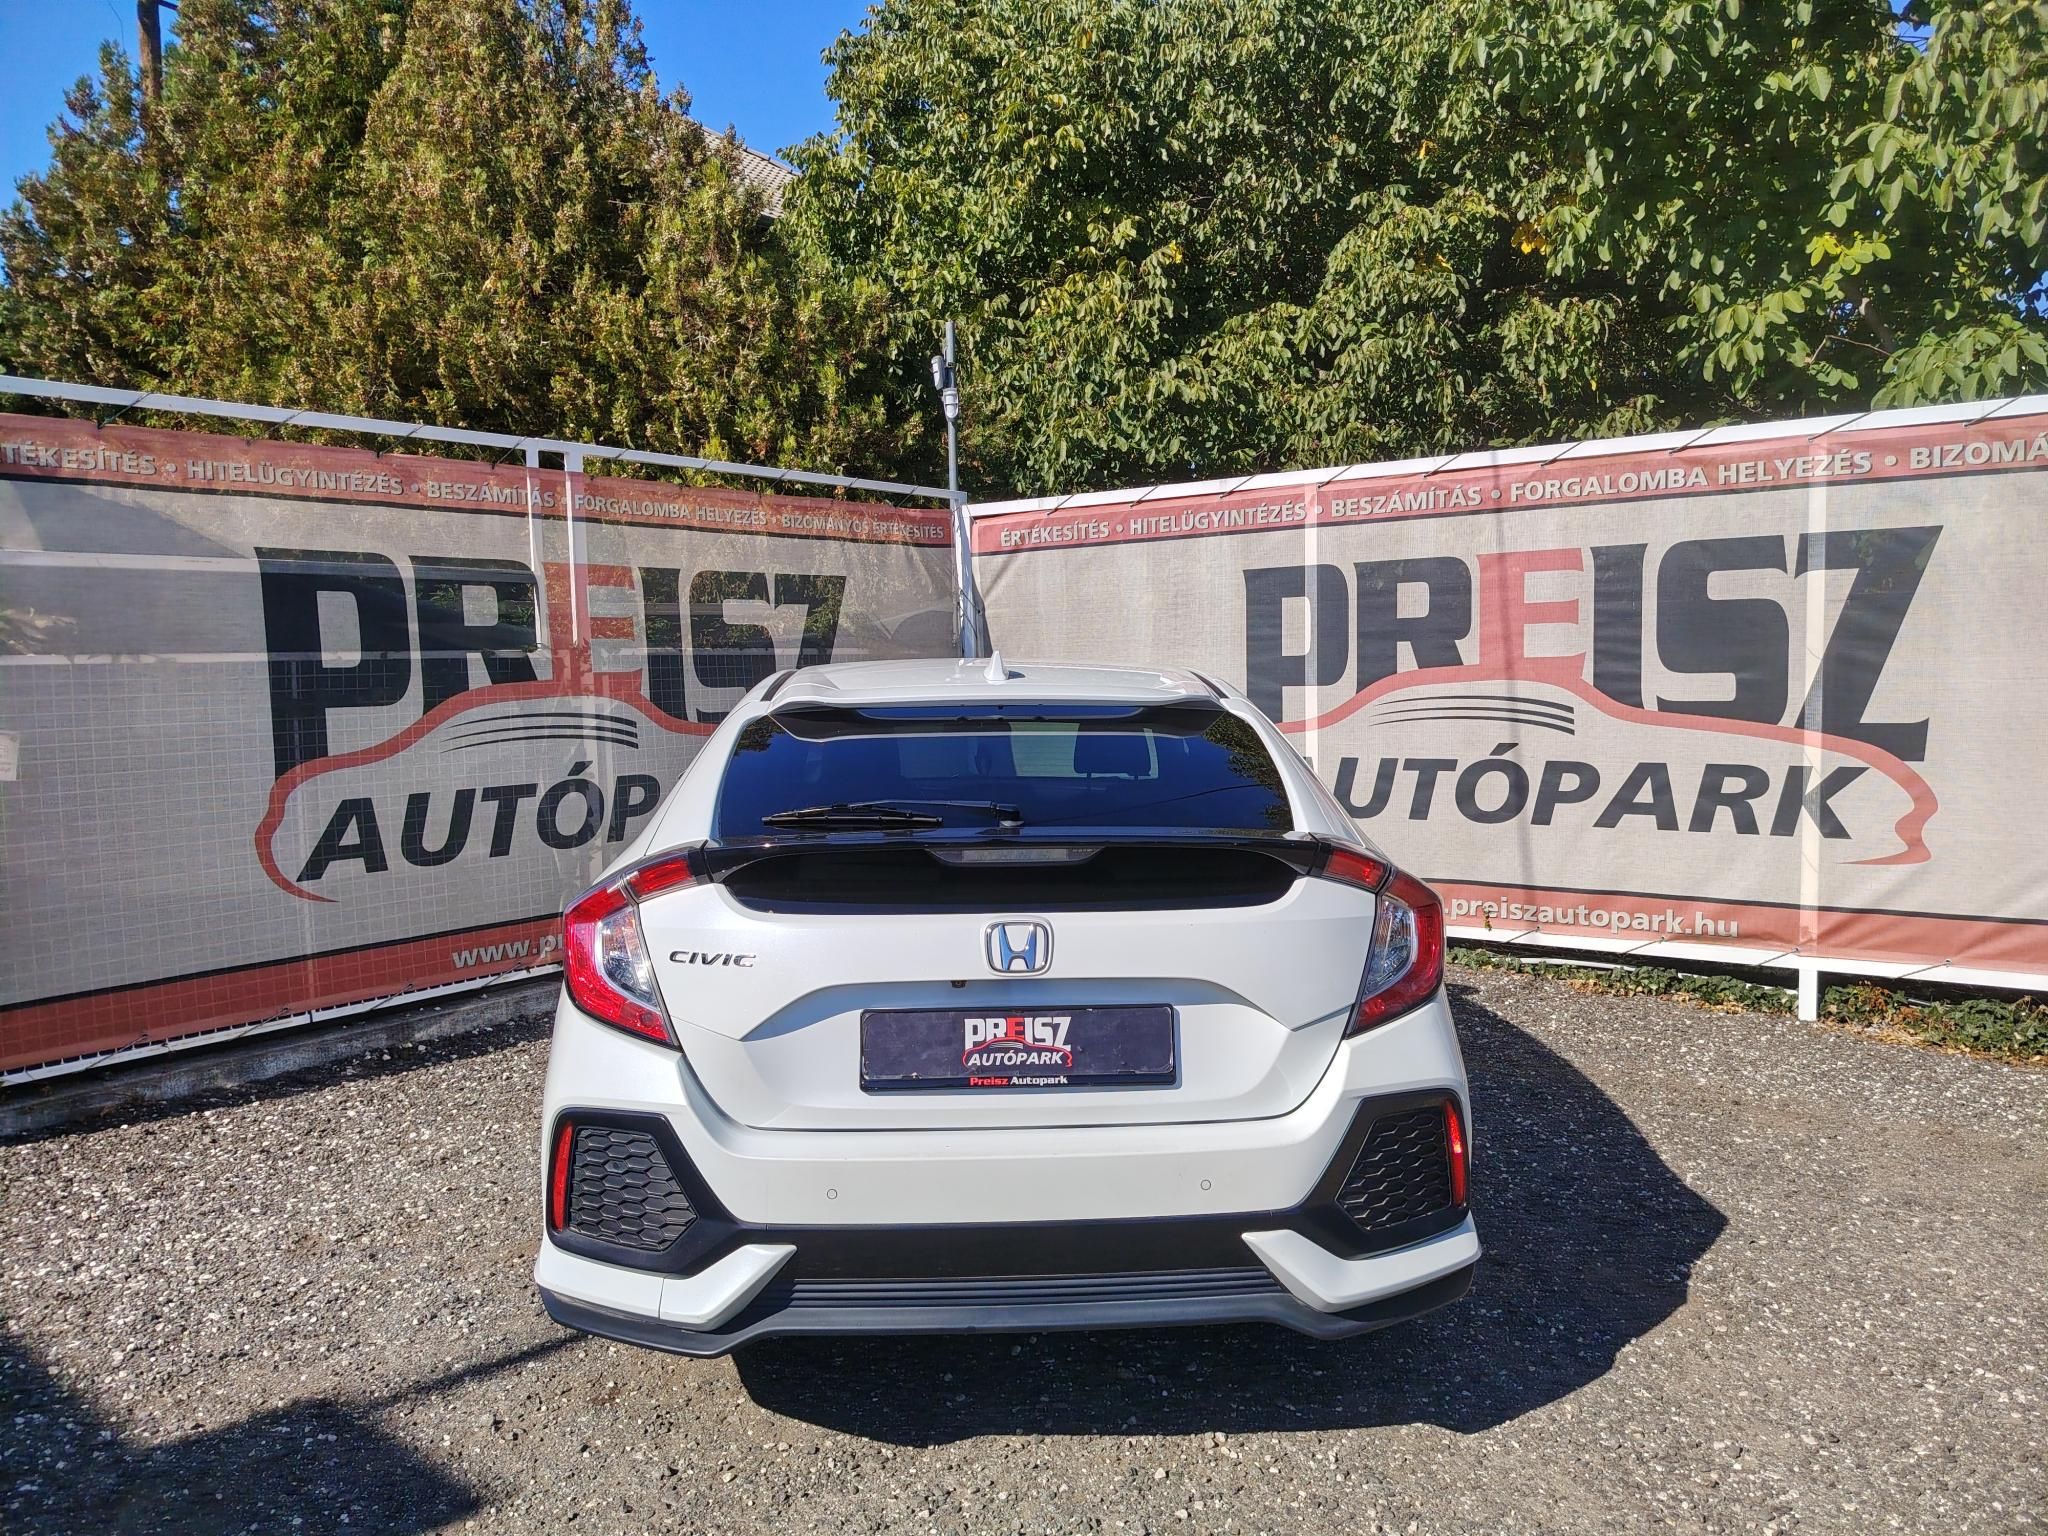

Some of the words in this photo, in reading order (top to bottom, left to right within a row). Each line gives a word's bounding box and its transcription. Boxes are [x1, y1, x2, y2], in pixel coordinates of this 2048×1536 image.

[0, 441, 157, 475] TÉKESÍTÉS
[186, 460, 405, 495] HITELÜGYINTÉZÉS
[427, 481, 556, 508] BESZÁMÍTÁS
[575, 494, 692, 519] FORGALOMBA
[695, 506, 767, 526] HELYEZÉS
[1000, 518, 1110, 547] ÉRTÉKESÍTÉS
[1129, 500, 1307, 535] HITELÜGYINTÉZÉS
[1331, 485, 1483, 518] BESZÁMÍTÁS
[1510, 466, 1710, 502] FORGALOMBA
[1717, 448, 1873, 486] HELYEZÉS
[1910, 431, 2048, 470] BIZOMÁ
[1242, 525, 1943, 761] PREISZ
[296, 761, 684, 882] AUTÓP
[1303, 742, 1871, 840] UTÓPARK
[669, 950, 757, 968] CIVIC
[963, 1016, 1073, 1053] PREISZ
[967, 1050, 1065, 1067] AUTÓPARK
[969, 1076, 1010, 1087] Preisz
[1010, 1075, 1069, 1087] Autopark
